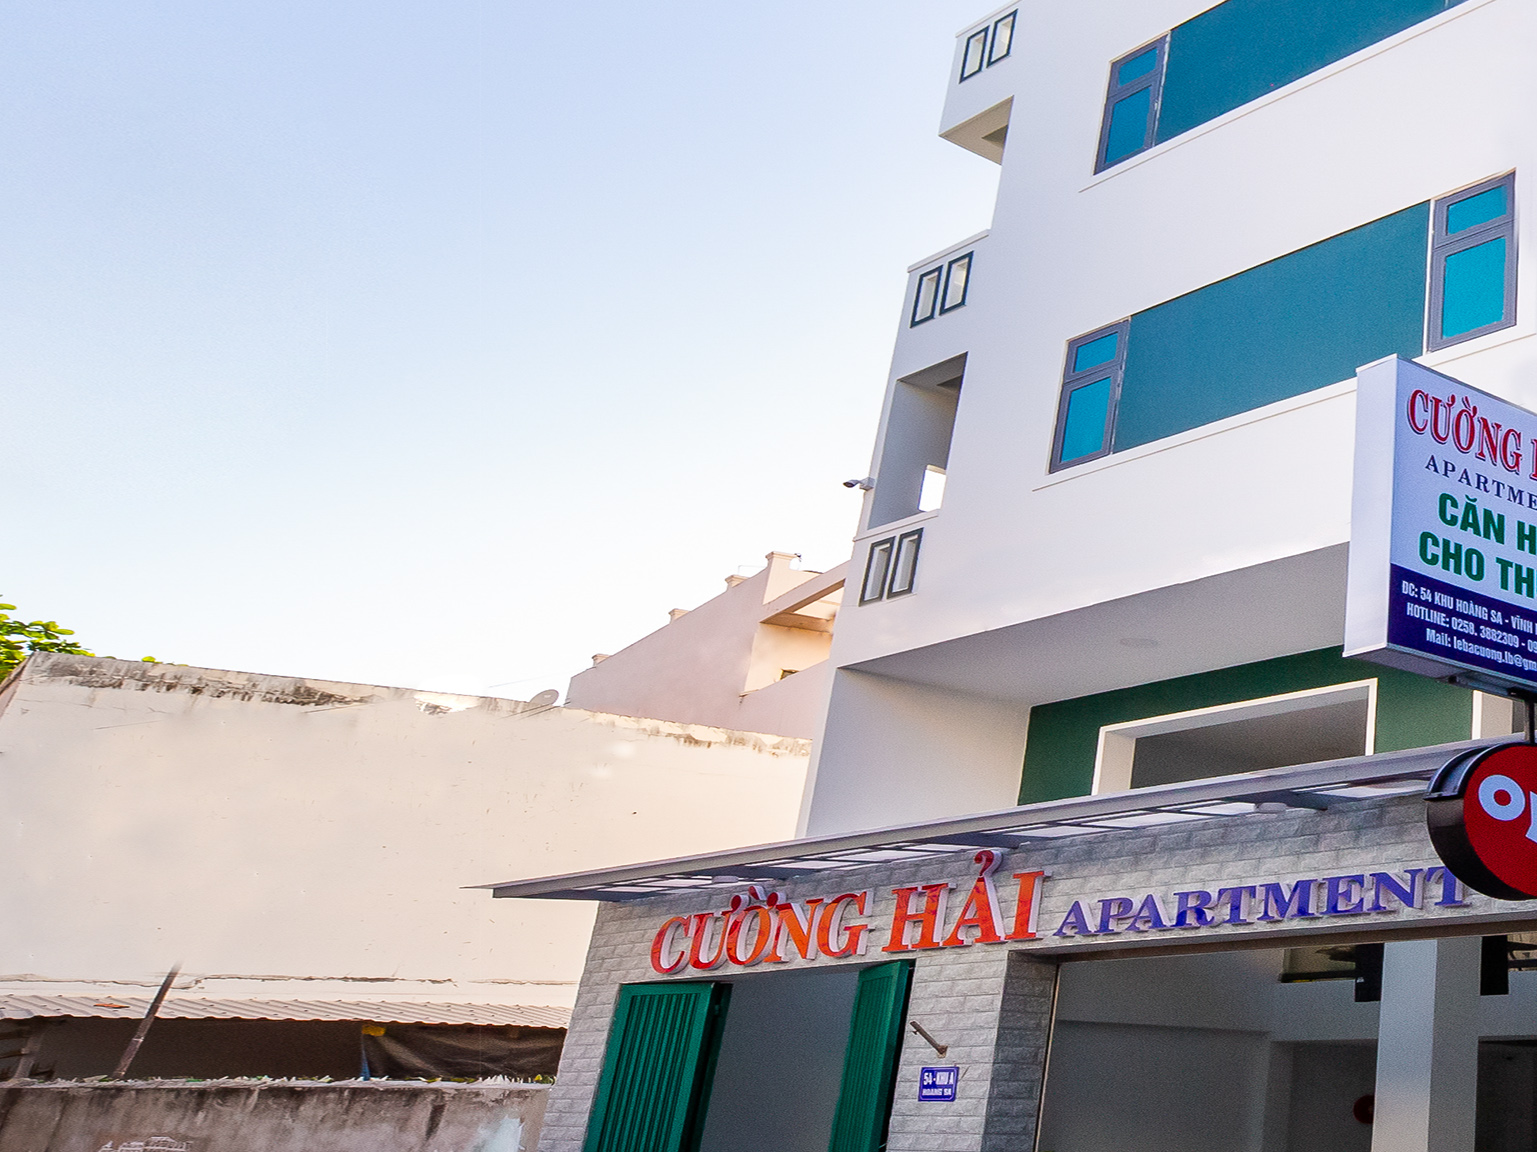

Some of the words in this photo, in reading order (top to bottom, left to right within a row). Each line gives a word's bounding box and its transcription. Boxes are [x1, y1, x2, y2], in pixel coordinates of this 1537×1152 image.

[1407, 389, 1522, 475] CƯỜNG
[1438, 492, 1505, 545] CĂN
[1419, 531, 1486, 582] CHO
[1406, 602, 1450, 627] HOTLINE:
[1420, 587, 1432, 602] 54
[1434, 592, 1454, 609] KHU
[1456, 598, 1488, 620] HOÀNG
[1490, 610, 1503, 625] SA
[1426, 628, 1451, 647] Mail:
[650, 885, 872, 975] CƯỜNG
[882, 850, 1050, 952] HẢI
[1053, 865, 1471, 937] APARTMENT
